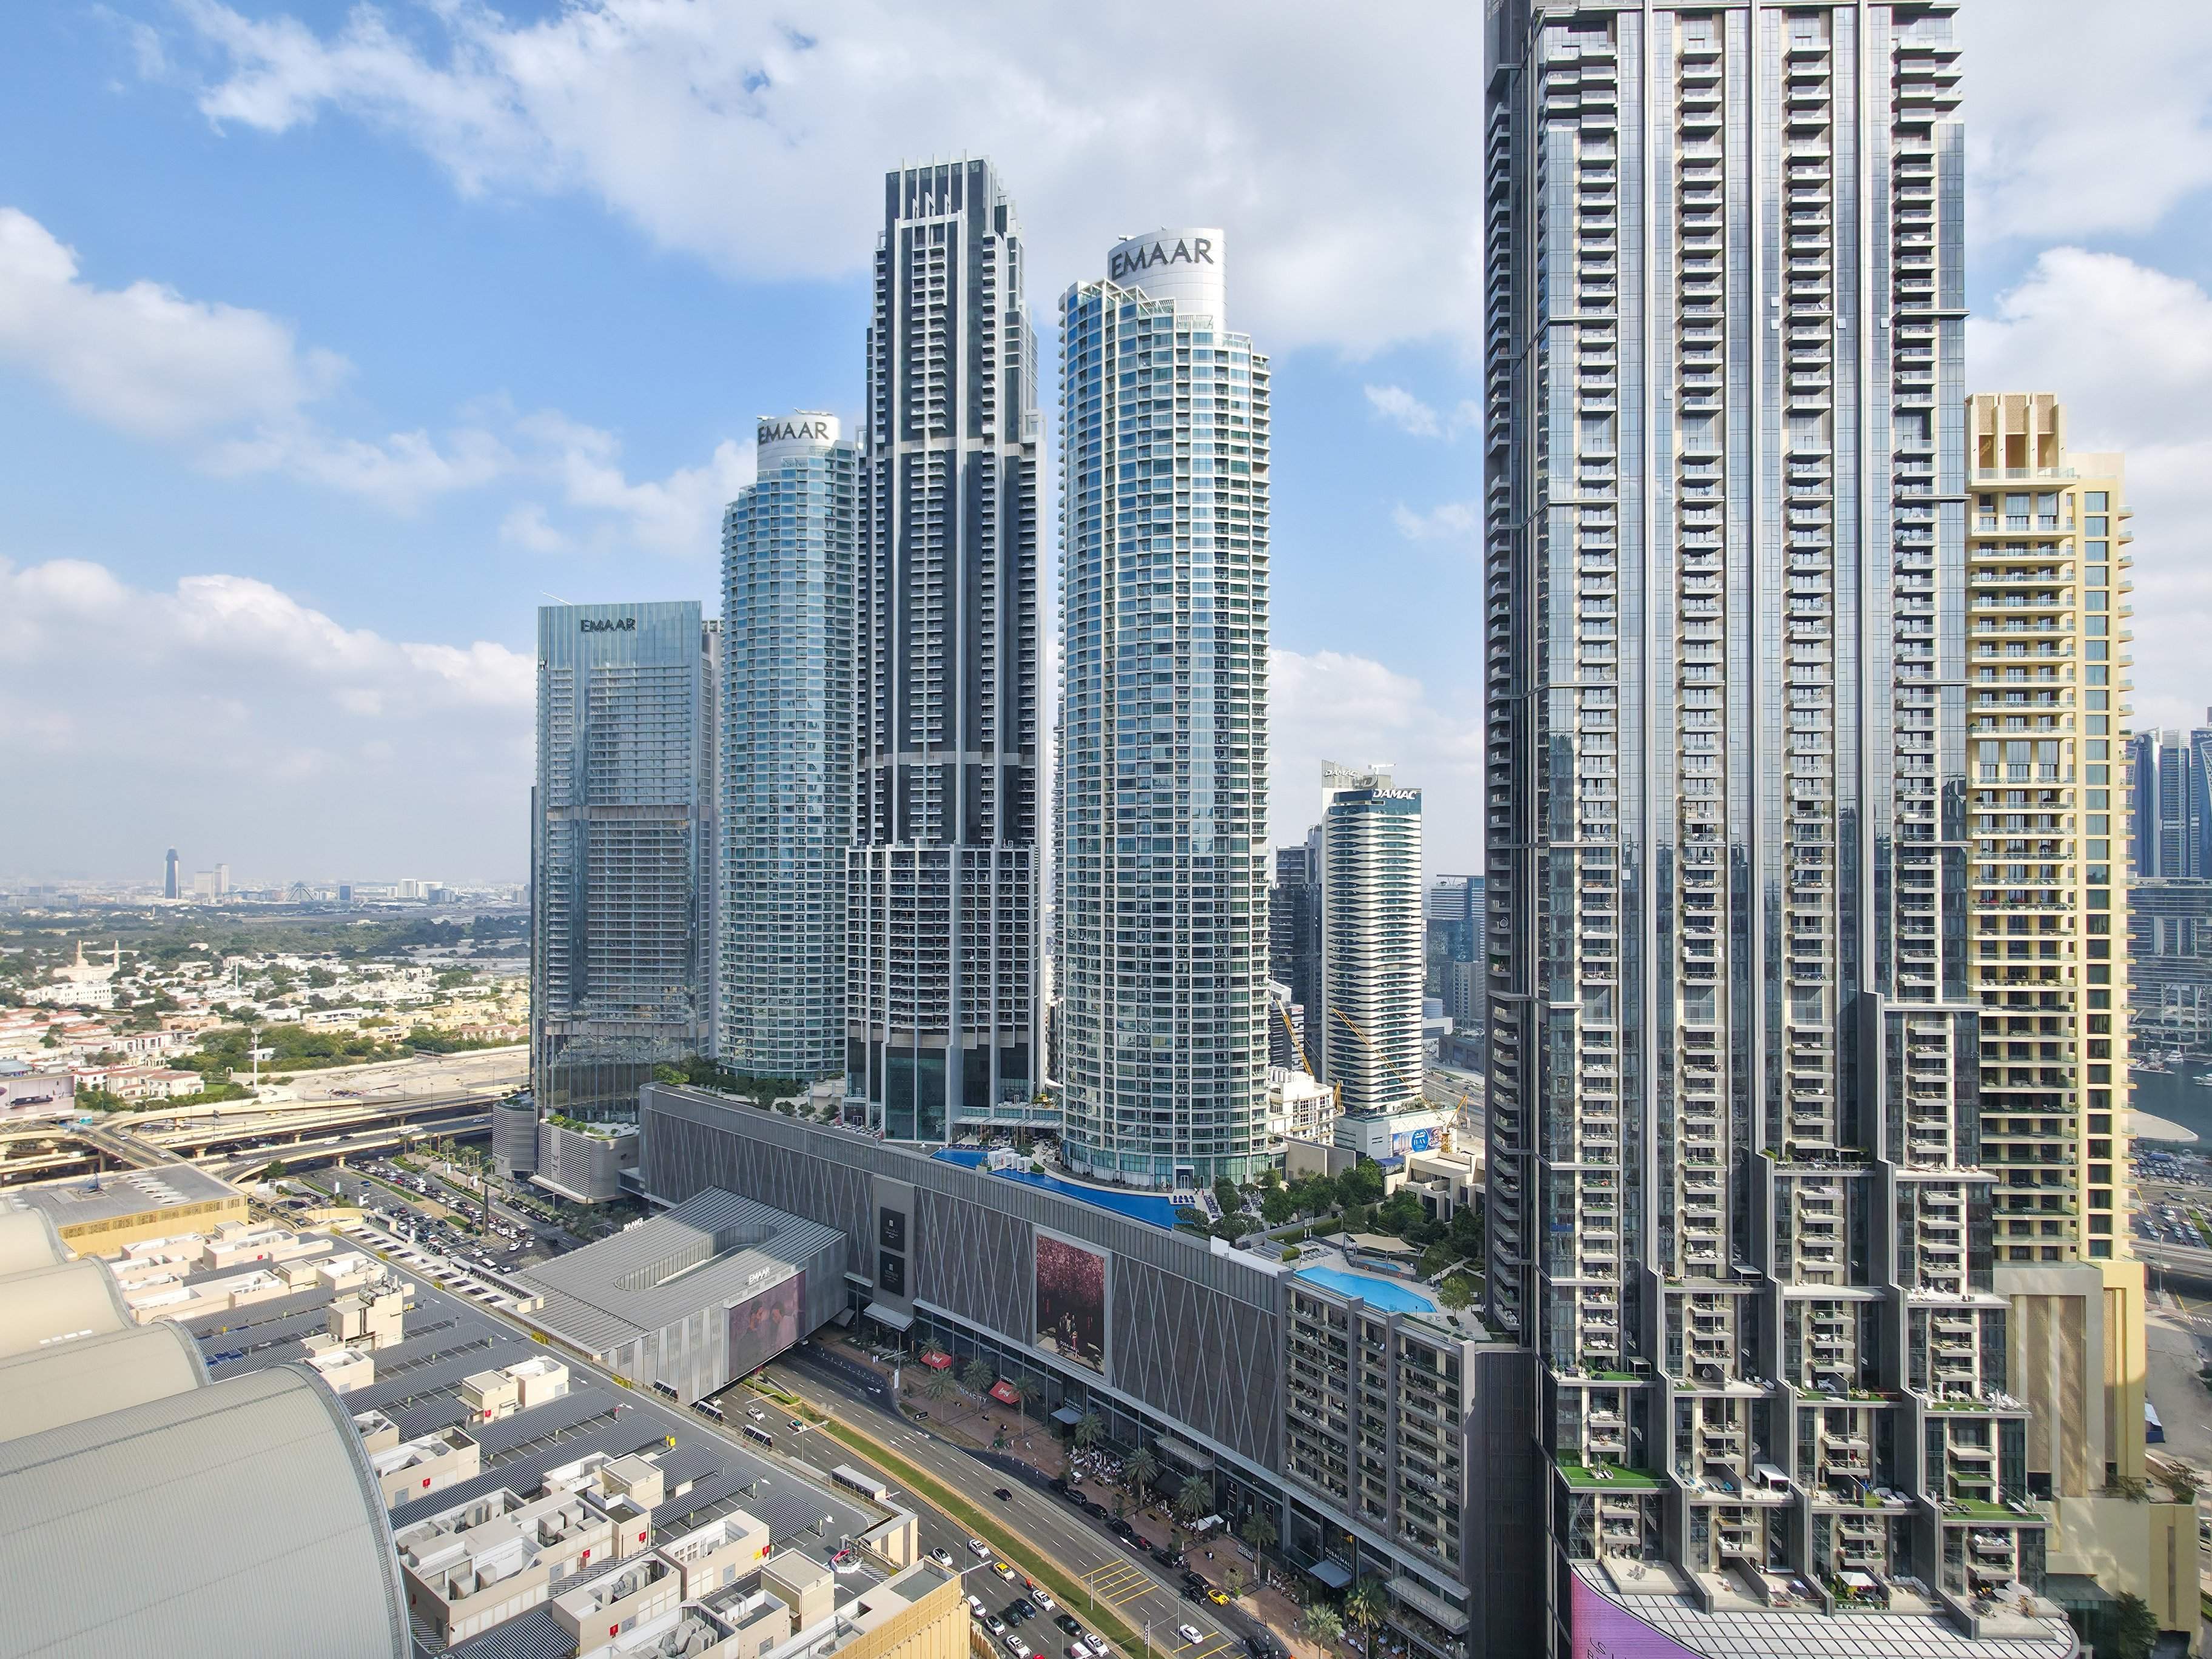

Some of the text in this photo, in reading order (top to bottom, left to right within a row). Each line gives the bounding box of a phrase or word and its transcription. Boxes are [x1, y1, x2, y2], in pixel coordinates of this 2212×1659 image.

[1112, 238, 1214, 280] EMAAR
[758, 422, 829, 445] EMAAR
[580, 618, 636, 632] EMAAR
[1373, 789, 1417, 800] DAMAC
[749, 1267, 770, 1285] EMAAR
[1325, 1547, 1339, 1560] DUBAI
[1340, 1557, 1353, 1569] MALL
